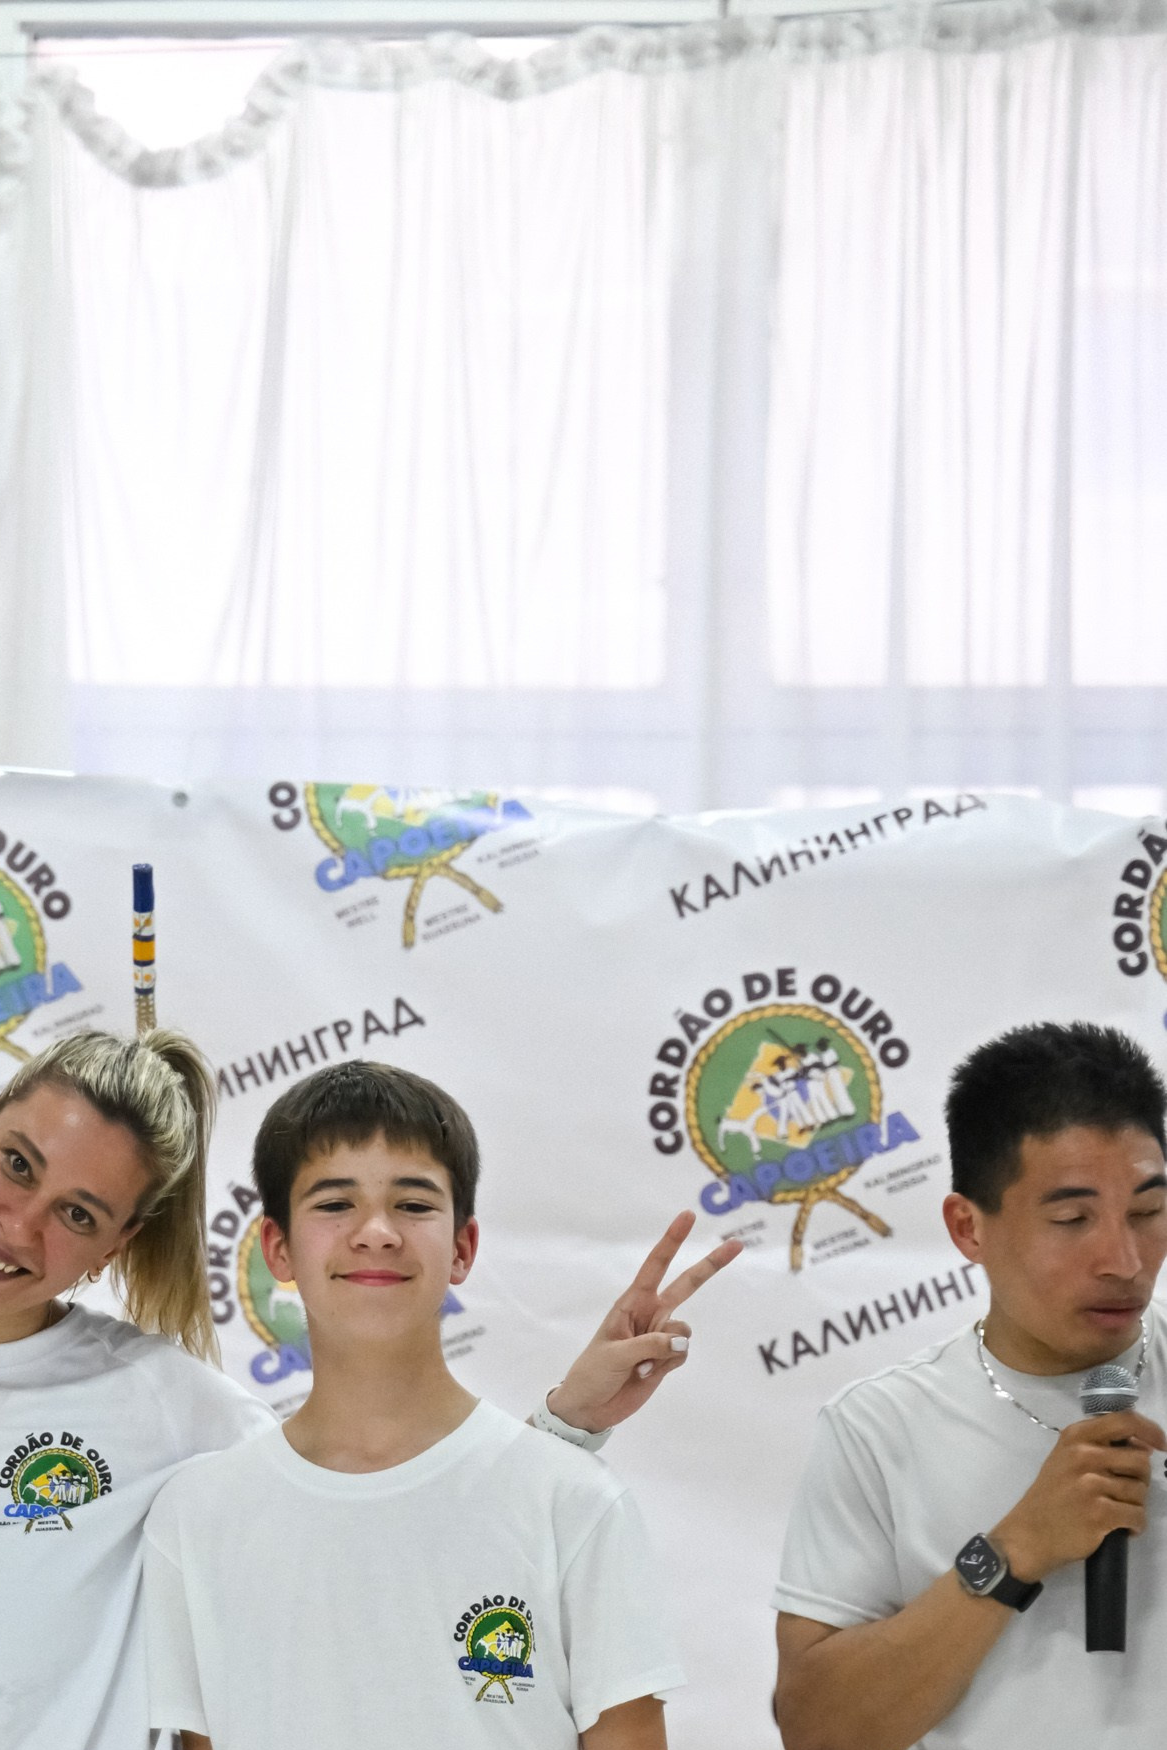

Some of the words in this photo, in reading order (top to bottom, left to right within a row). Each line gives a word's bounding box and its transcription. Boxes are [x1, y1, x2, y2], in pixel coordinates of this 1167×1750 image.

[1113, 828, 1167, 978] CORDÃ
[217, 997, 426, 1098] ИНИНГРАД
[648, 989, 733, 1155] CORDÃO
[743, 967, 796, 1002] DE
[811, 973, 910, 1070] OURO
[699, 1110, 921, 1217] CAPOEIRA
[208, 1181, 262, 1324] CORDÃ
[758, 1263, 976, 1375] КАЛИНИНГ
[60, 1431, 84, 1451] DE
[3, 1503, 69, 1519] CAPO
[453, 1594, 505, 1642] CORDÃO
[508, 1596, 526, 1612] DE
[458, 1656, 534, 1678] CAPOEIRA
